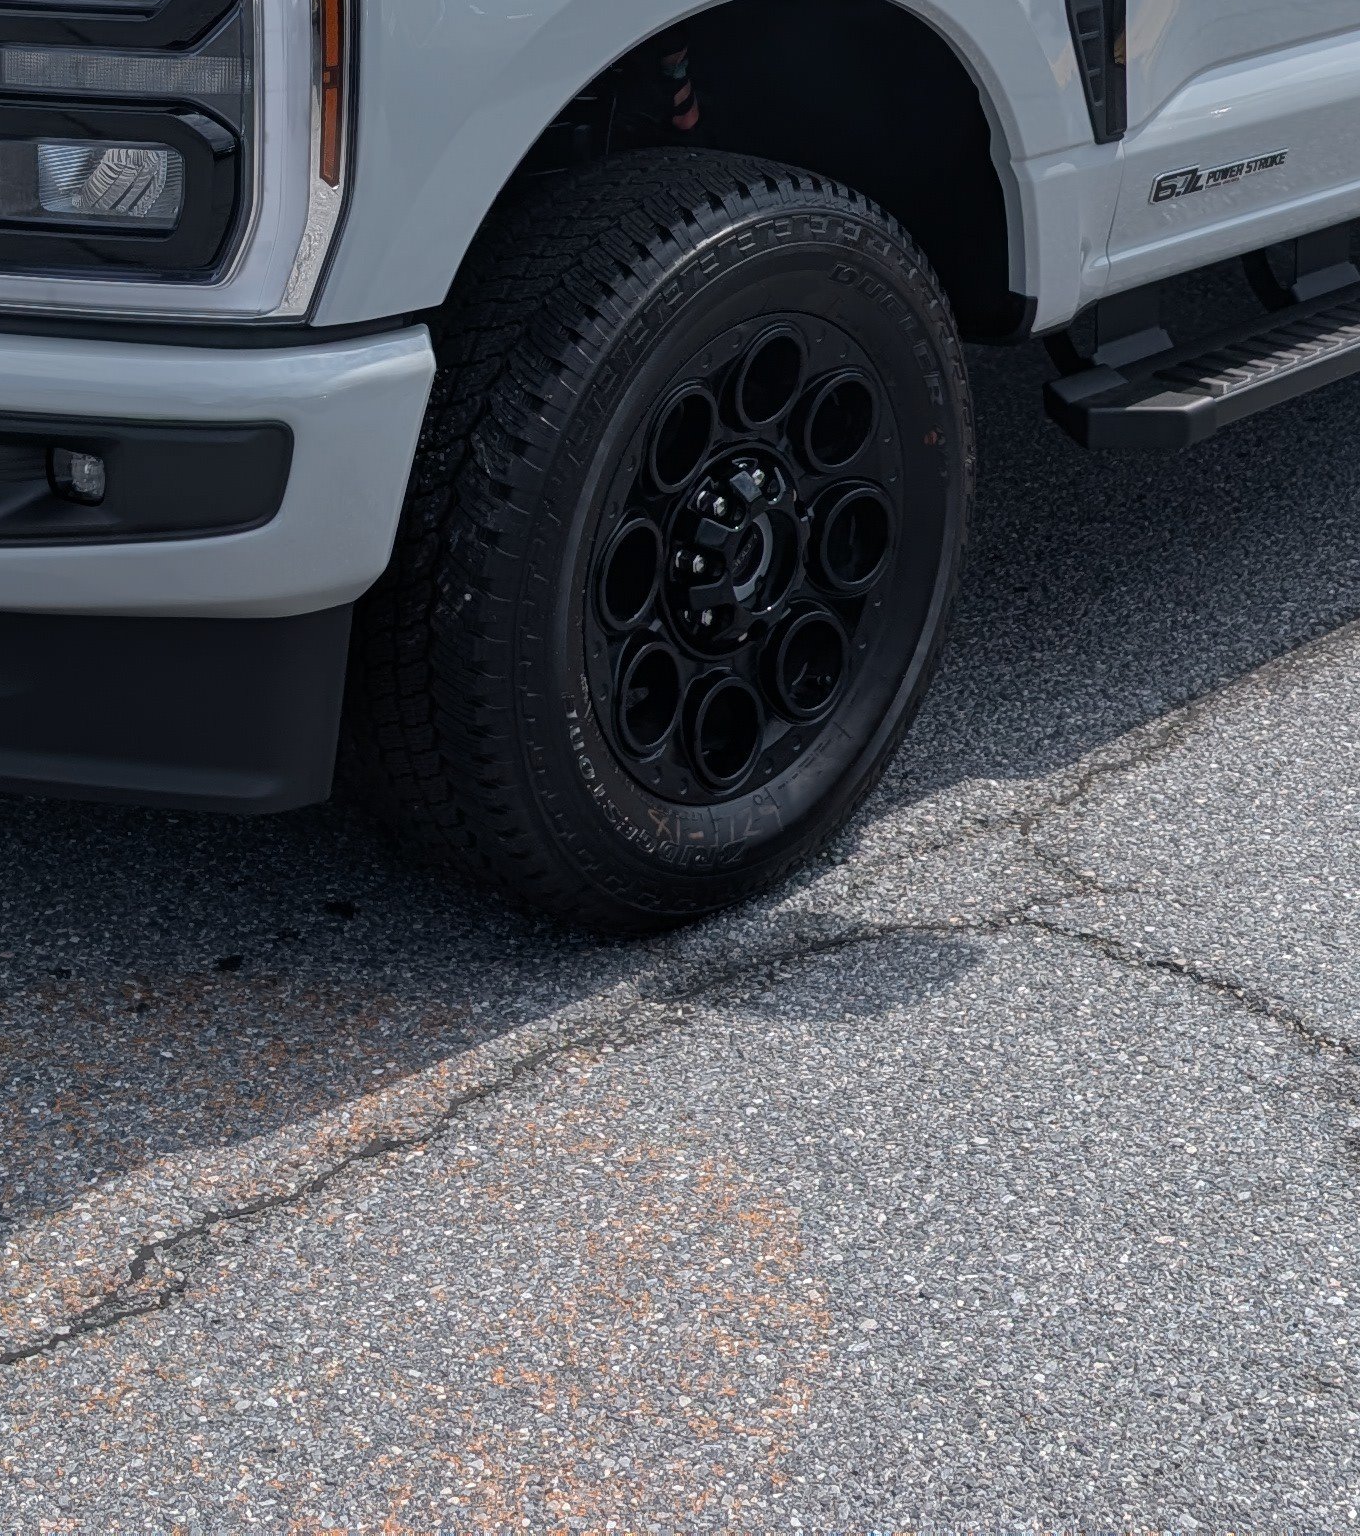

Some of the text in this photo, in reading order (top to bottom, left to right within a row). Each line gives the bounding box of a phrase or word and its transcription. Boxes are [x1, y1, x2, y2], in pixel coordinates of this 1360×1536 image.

[1152, 167, 1204, 203] 6.7L
[1205, 163, 1244, 185] POWER
[1244, 151, 1290, 174] STROKE
[828, 260, 944, 406] DUELER
